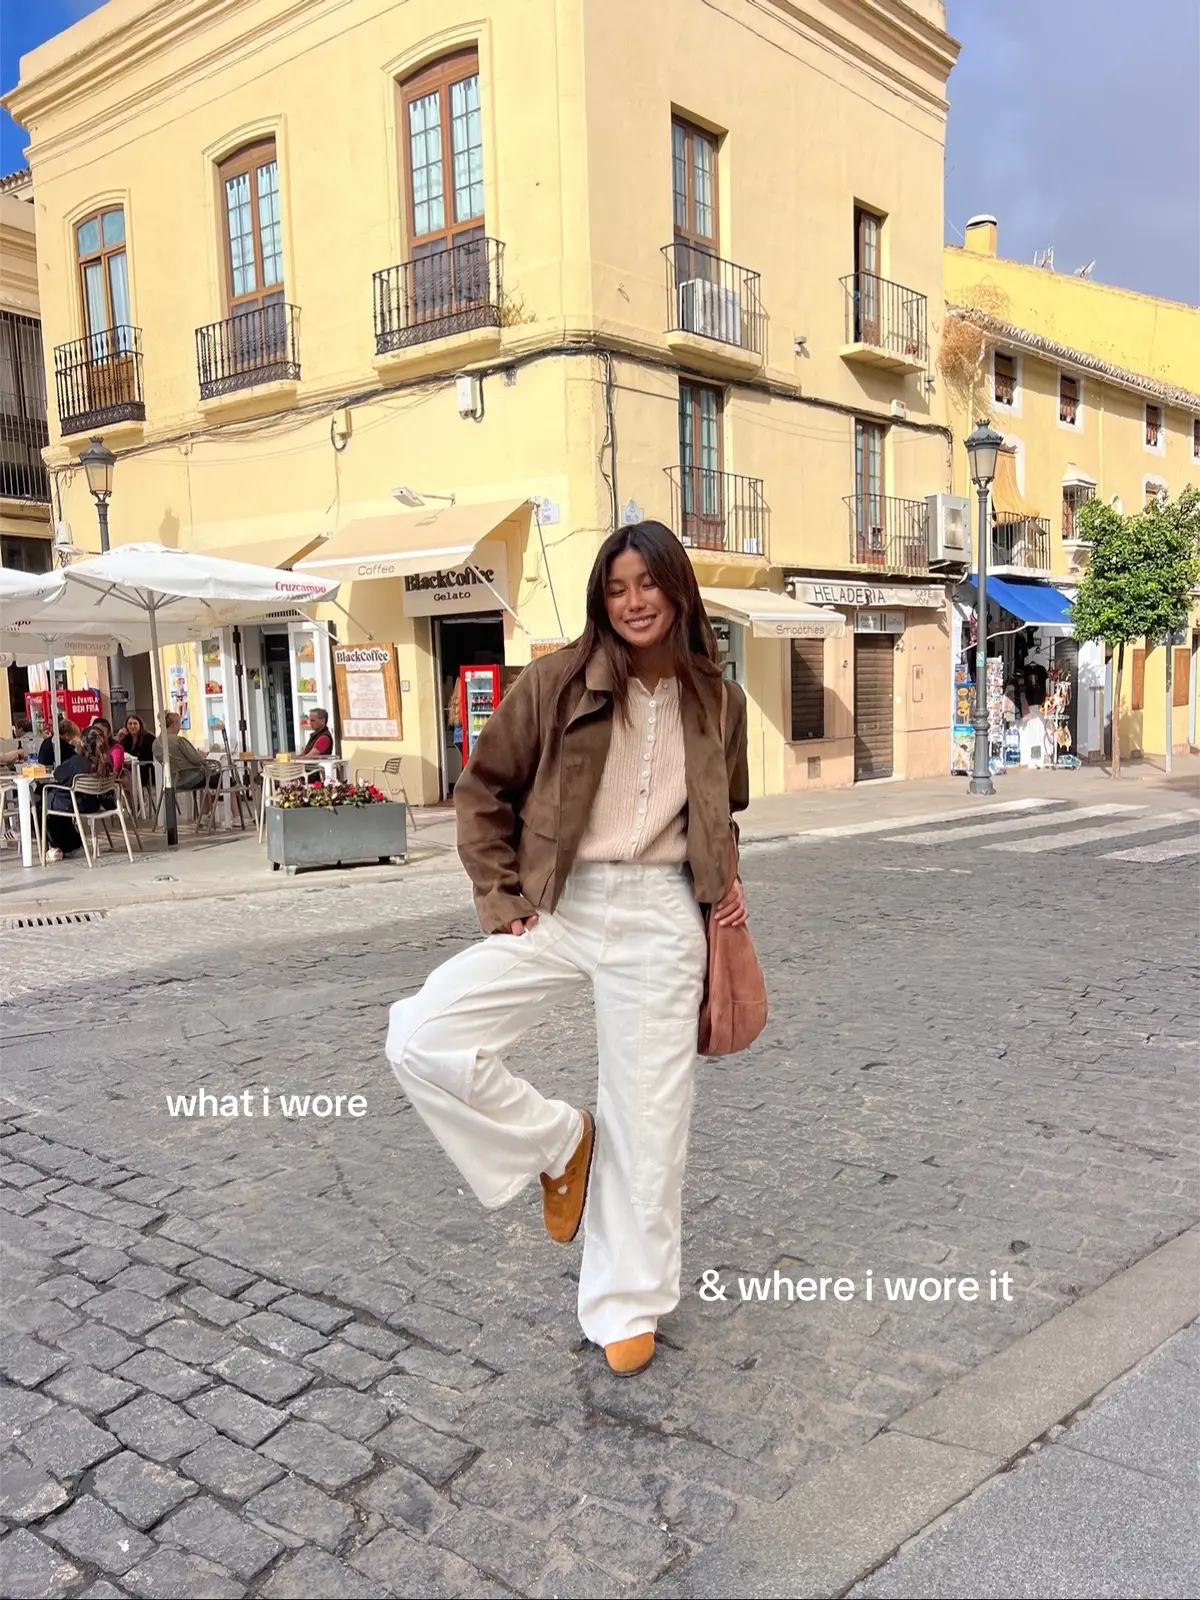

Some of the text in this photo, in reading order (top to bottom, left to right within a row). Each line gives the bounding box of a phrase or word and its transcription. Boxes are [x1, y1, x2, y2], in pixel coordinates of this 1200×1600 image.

[358, 564, 395, 576] Coffee
[404, 566, 494, 592] BlackCoffee
[275, 581, 327, 594] Cruzcampo
[433, 590, 471, 601] Gelato
[776, 625, 825, 635] Smoothies
[336, 650, 389, 663] BlackCoffee
